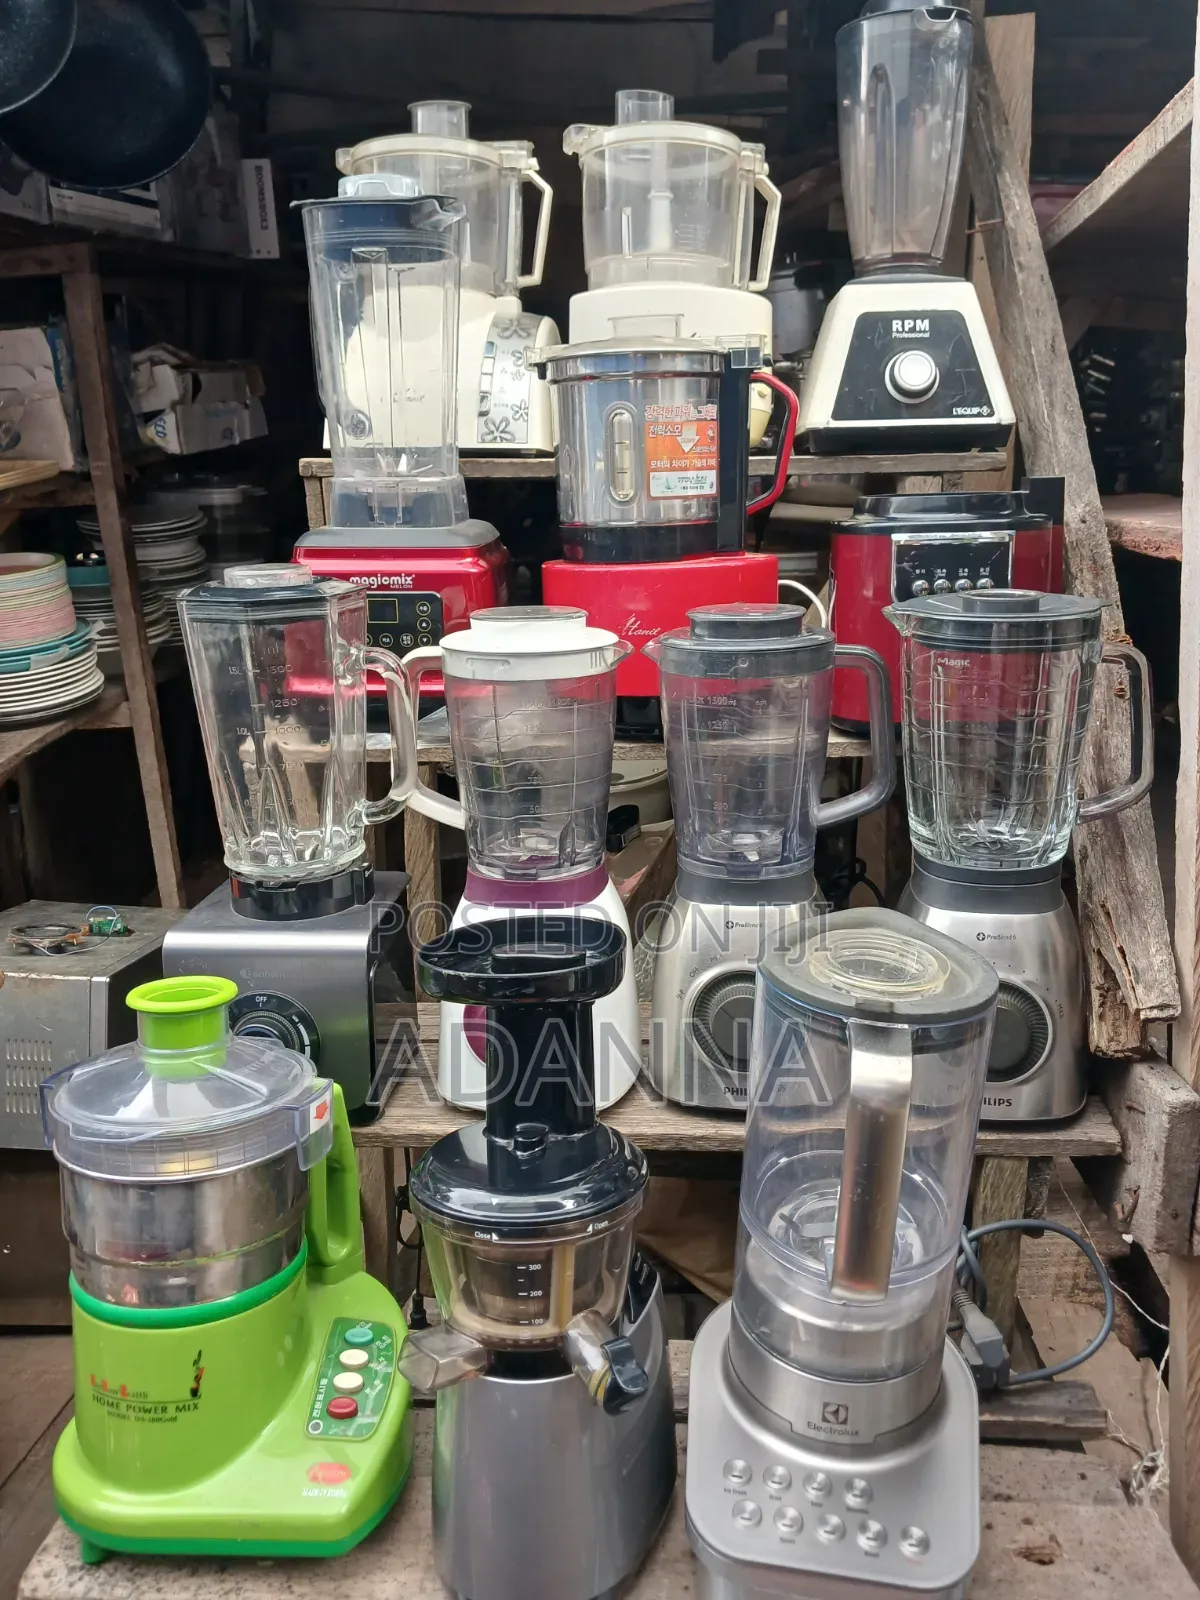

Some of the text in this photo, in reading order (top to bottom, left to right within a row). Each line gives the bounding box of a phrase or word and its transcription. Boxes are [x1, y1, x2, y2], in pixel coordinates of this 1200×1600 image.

[892, 318, 930, 332] RPM
[892, 331, 930, 339] Professional
[349, 573, 413, 588] magicmix
[937, 657, 971, 668] Magic
[265, 664, 294, 674] 1500
[275, 724, 302, 735] 1000
[594, 1220, 609, 1230] Open
[474, 1231, 491, 1240] Close
[528, 1263, 541, 1271] 300
[92, 1393, 199, 1415] HOME POWER MIX
[807, 1421, 859, 1437] Electrolux
